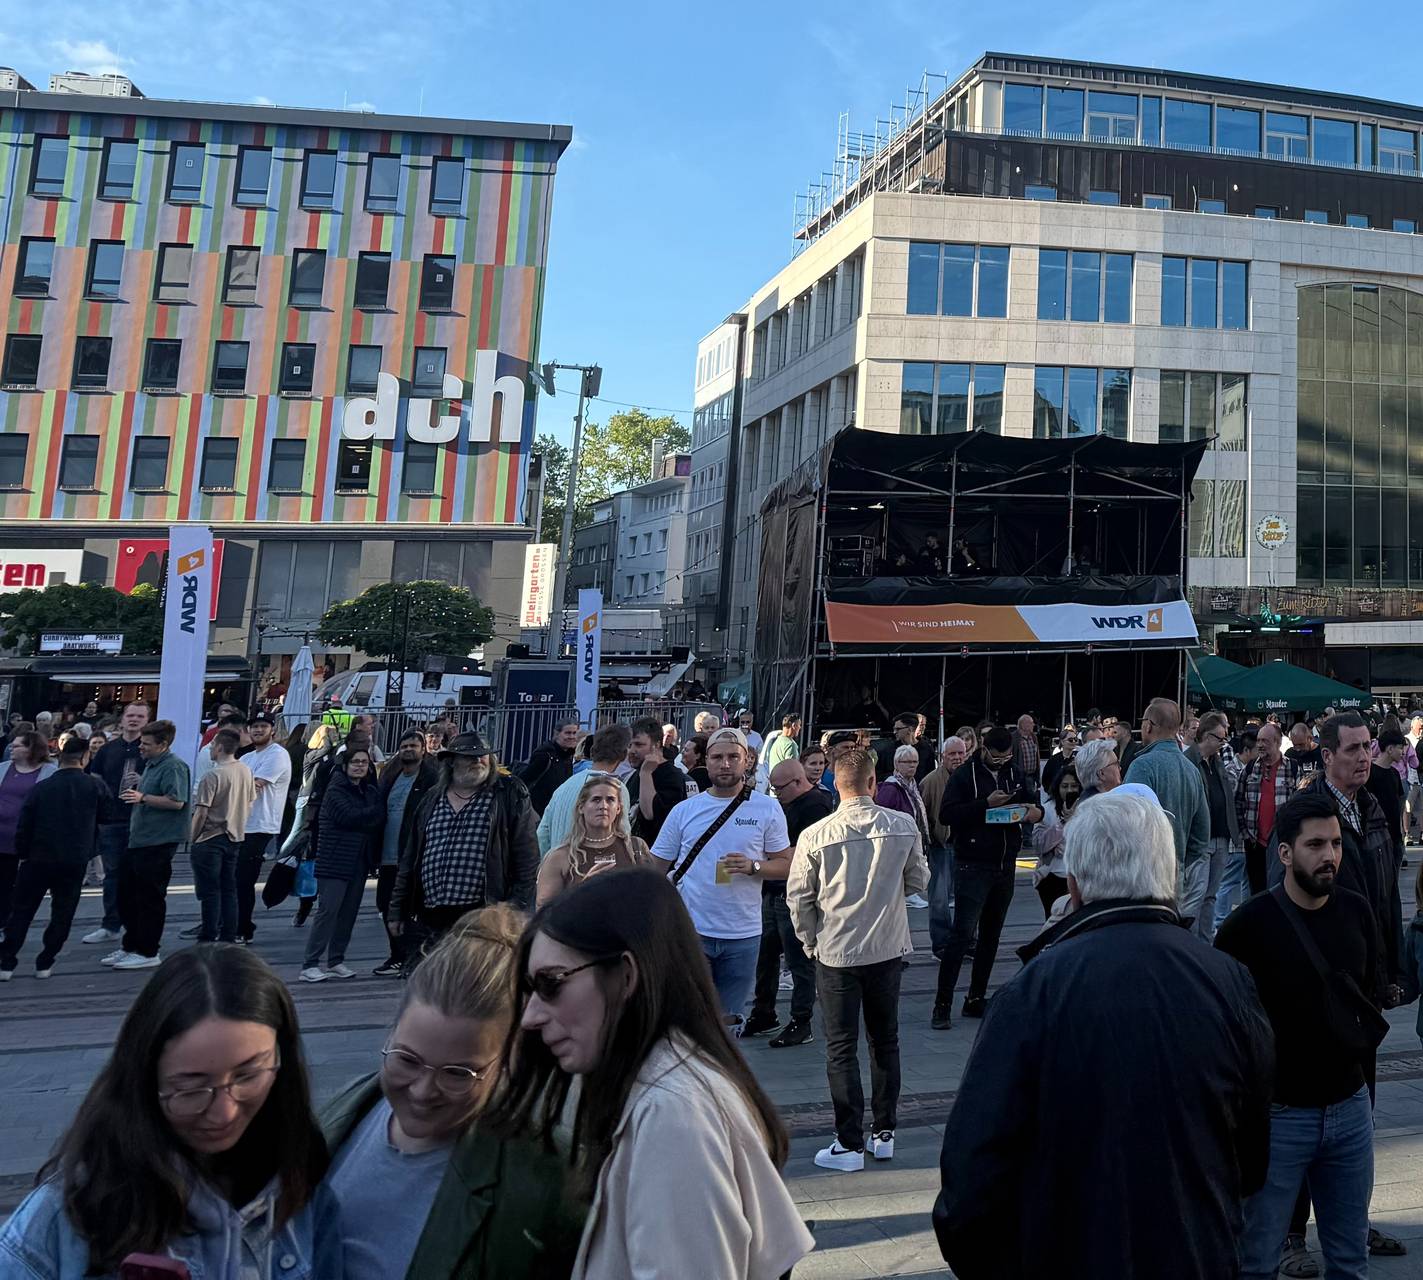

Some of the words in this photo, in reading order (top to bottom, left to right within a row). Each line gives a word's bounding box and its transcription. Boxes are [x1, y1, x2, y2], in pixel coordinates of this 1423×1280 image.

[0, 563, 46, 587] en
[526, 555, 541, 623] Weingarten
[1277, 598, 1298, 612] Zum
[1301, 595, 1330, 610] Ritter
[1091, 615, 1146, 629] WDR
[1149, 612, 1159, 624] 4
[1265, 699, 1288, 709] Stauder
[1340, 698, 1361, 707] Stauder
[735, 817, 758, 827] Stauder
